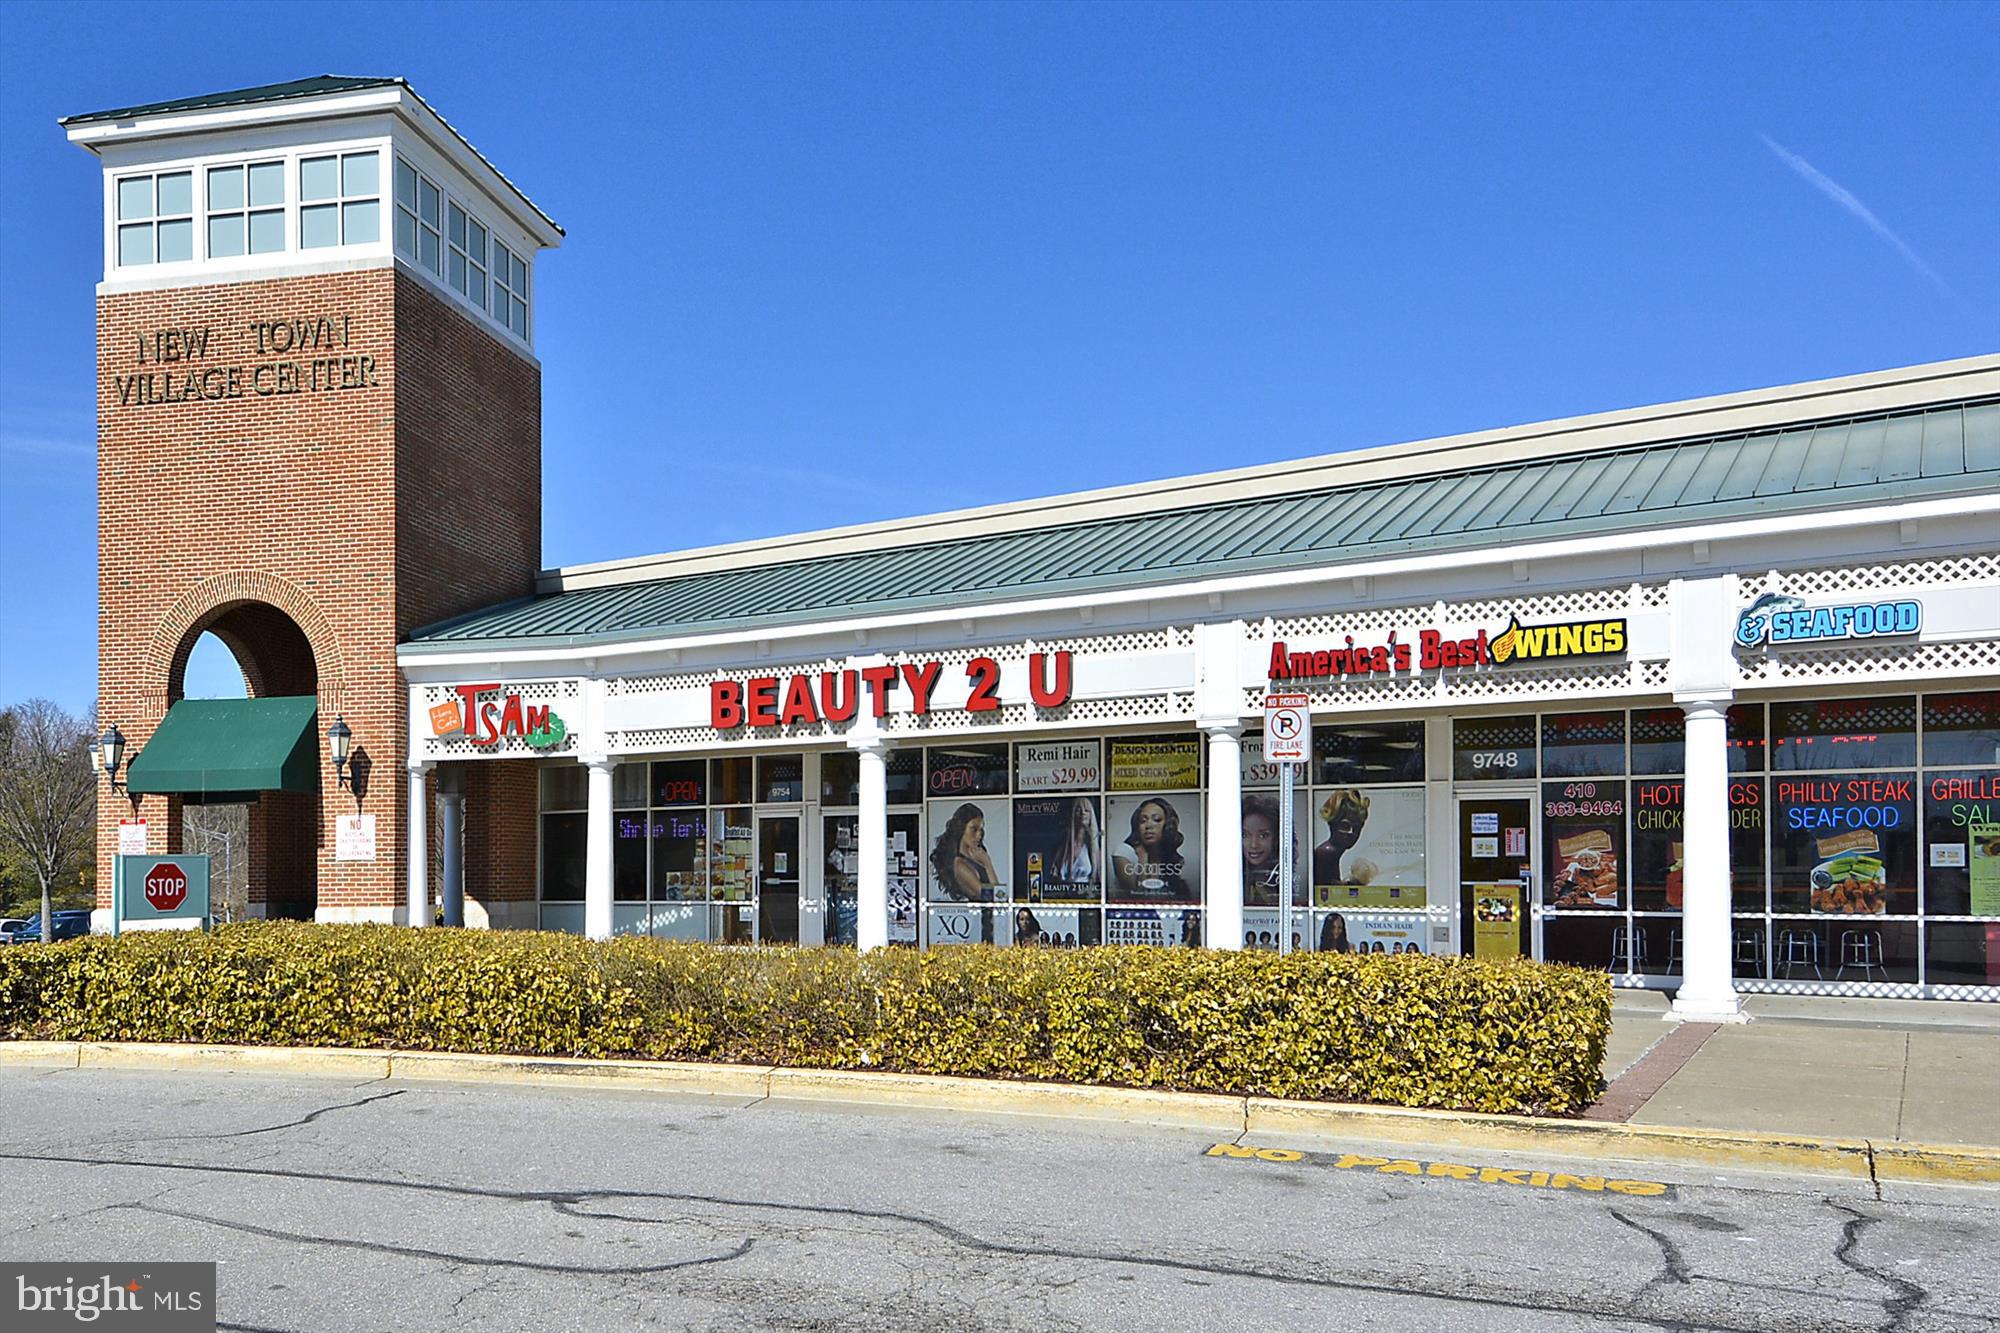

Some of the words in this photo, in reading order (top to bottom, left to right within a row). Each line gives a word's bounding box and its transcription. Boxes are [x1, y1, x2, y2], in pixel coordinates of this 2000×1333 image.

[138, 327, 210, 364] NEW
[251, 315, 349, 354] TOWN
[113, 366, 243, 406] VILLAGE
[253, 355, 379, 396] CENTER
[1772, 602, 1919, 641] SEAFOOD
[1513, 621, 1625, 659] WINGS
[1268, 630, 1410, 679] America's
[1419, 629, 1488, 670] Best
[710, 661, 944, 729] BEAUTY
[965, 657, 1001, 712] 2
[1029, 651, 1072, 708] U
[1028, 750, 1052, 761] Remi
[1062, 746, 1091, 761] Hair
[1270, 741, 1283, 750] FIRE
[1287, 741, 1303, 750] LANE
[1473, 752, 1518, 768] 9748
[931, 768, 974, 790] OPEN
[1021, 776, 1048, 786] START
[1052, 766, 1097, 784] $29.99
[664, 781, 698, 801] OPEN
[772, 786, 791, 798] 9754
[1564, 783, 1596, 798] 410
[1640, 785, 1682, 806] HOT
[1779, 782, 1841, 802] PHILLY
[1847, 780, 1912, 801] STEAK
[1545, 800, 1622, 817] 363-9464
[1788, 806, 1900, 829] SEAFOOD
[350, 819, 361, 830] NO
[1637, 810, 1682, 830] CHICK
[1124, 863, 1182, 876] GODDESS
[148, 879, 185, 896] STOP
[1044, 883, 1070, 892] BEAUTY
[1072, 883, 1077, 891] 2
[937, 914, 971, 940] XQ
[1366, 922, 1391, 930] INDIAN
[1205, 1143, 1302, 1162] NO
[1334, 1153, 1668, 1196] PARKING
